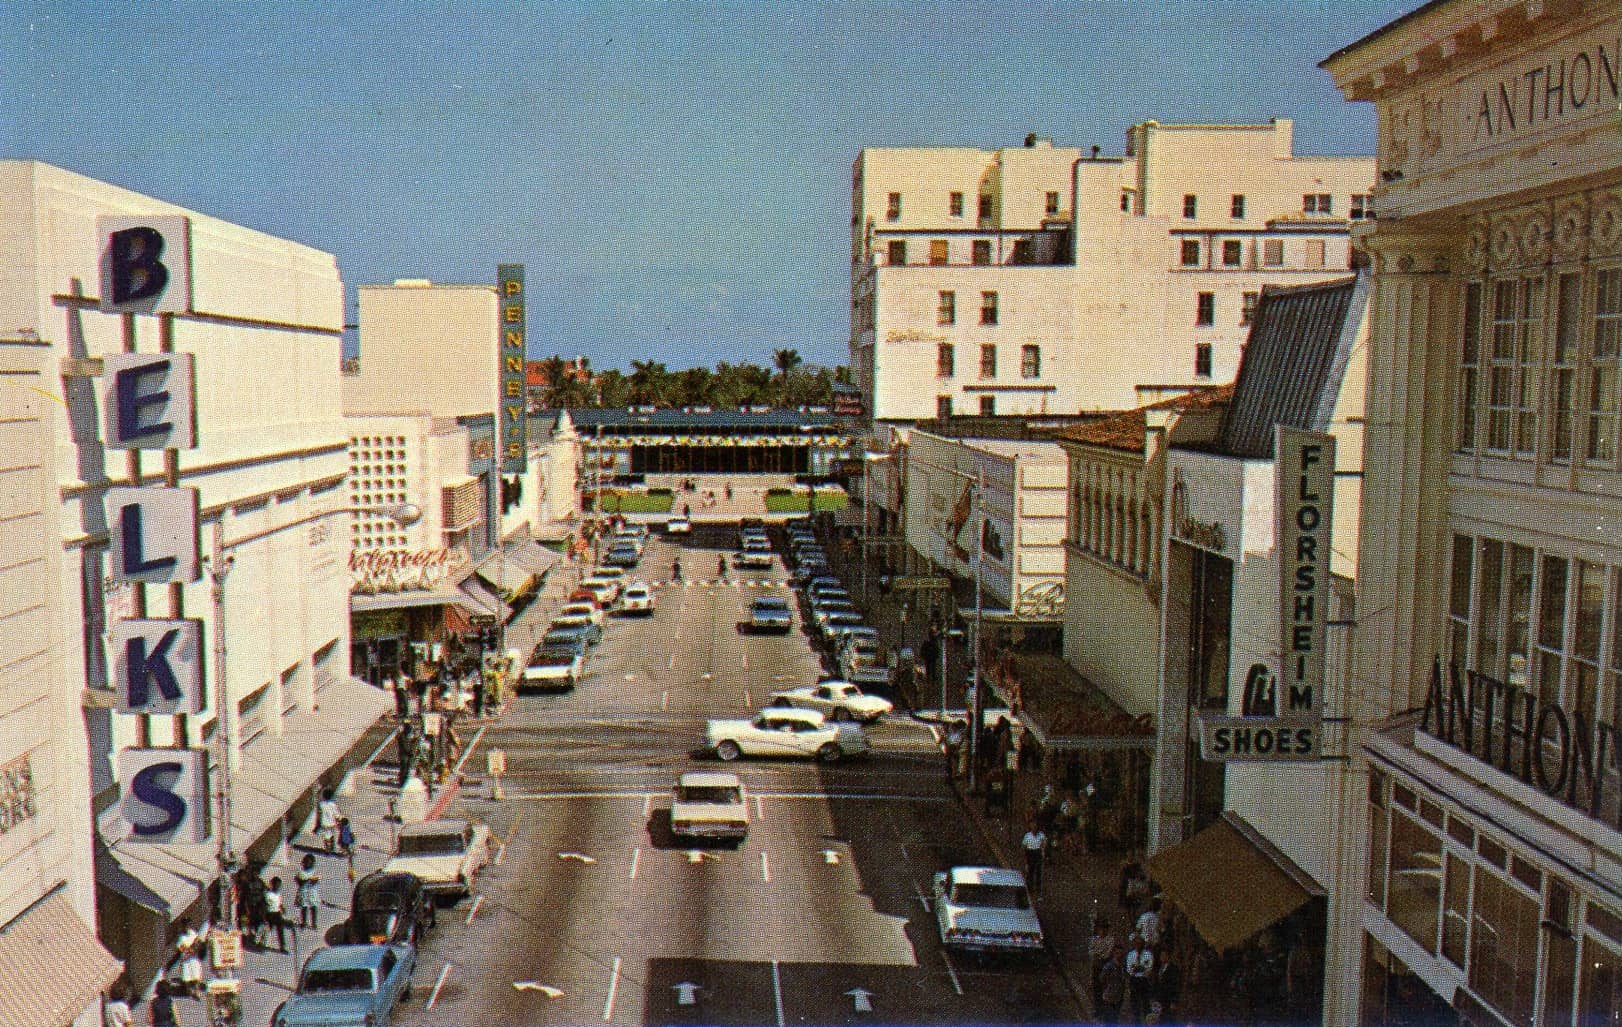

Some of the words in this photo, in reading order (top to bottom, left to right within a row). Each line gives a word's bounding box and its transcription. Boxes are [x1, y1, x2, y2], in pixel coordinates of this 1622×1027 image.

[111, 226, 187, 836] BELKS
[1289, 445, 1321, 710] FLORSHEIM
[1213, 727, 1313, 754] SHOES
